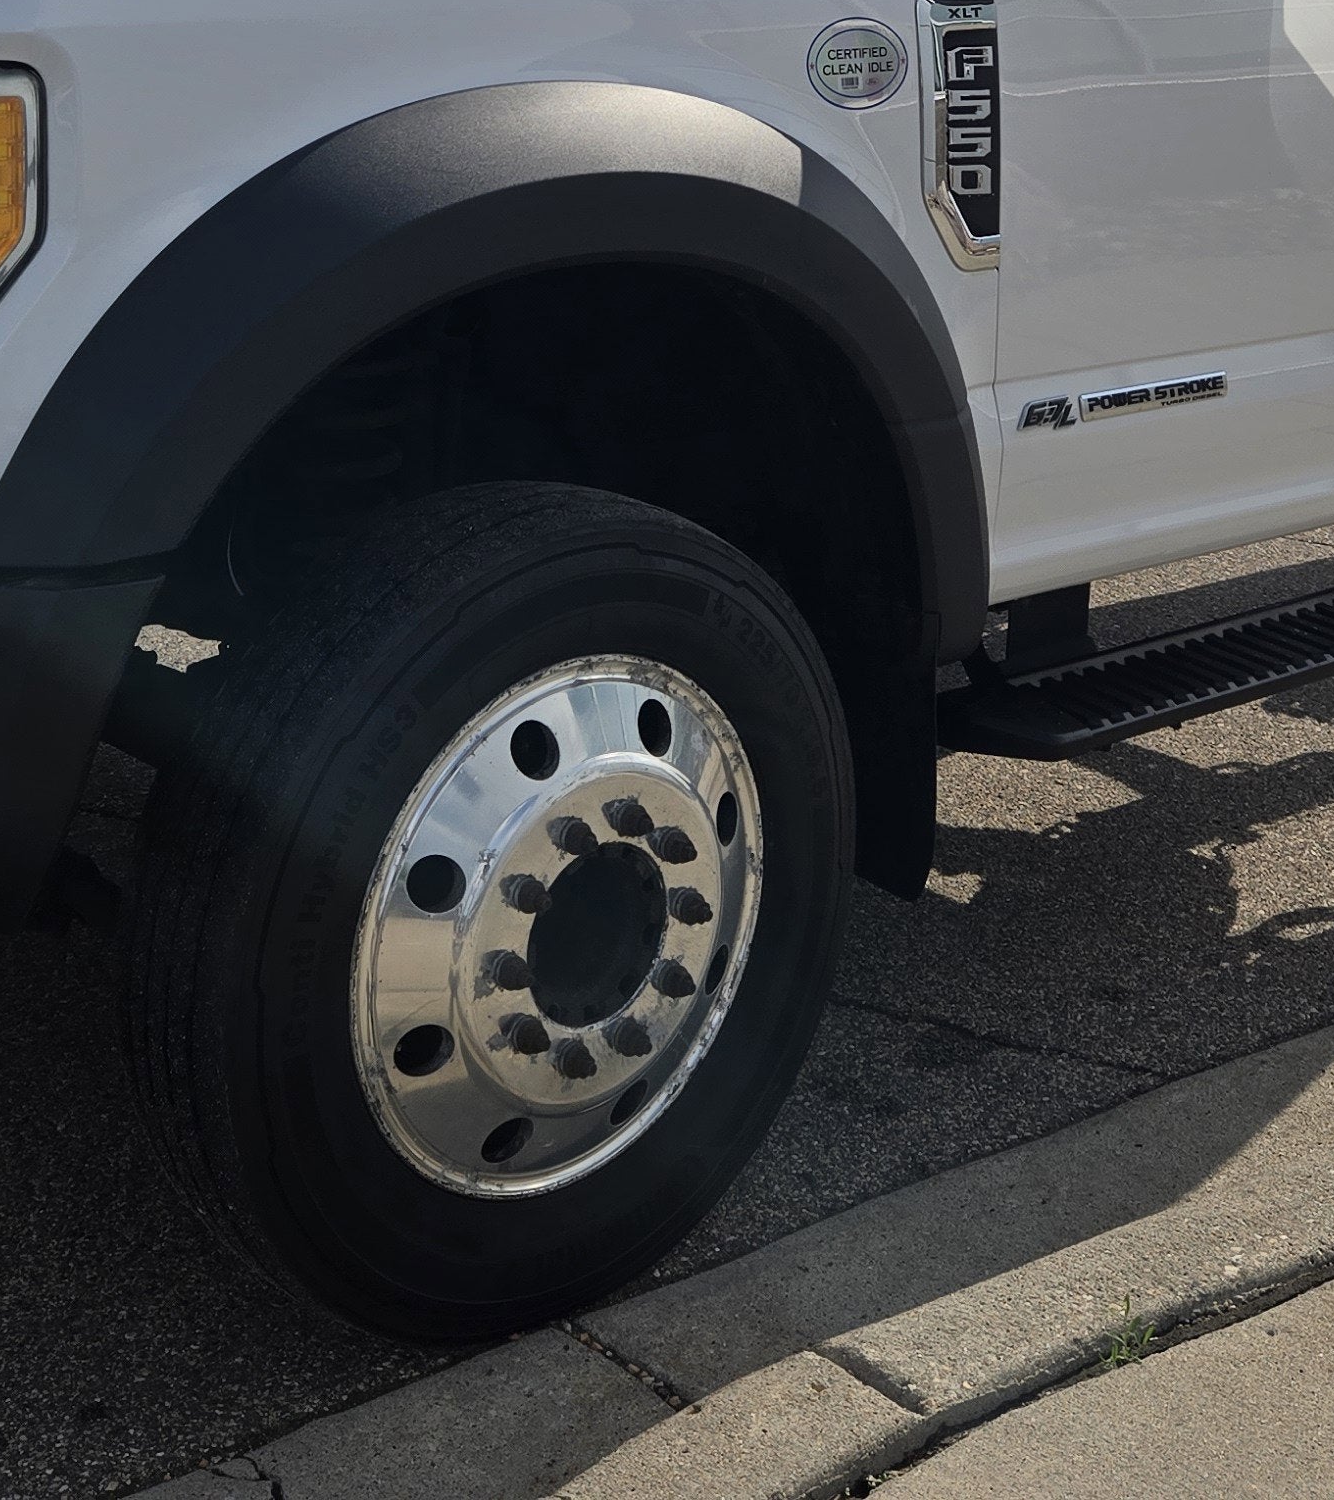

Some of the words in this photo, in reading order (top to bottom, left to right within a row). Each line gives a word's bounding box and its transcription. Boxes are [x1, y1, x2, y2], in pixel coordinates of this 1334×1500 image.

[947, 6, 983, 19] XLT
[827, 46, 888, 61] CERTIFIED
[822, 62, 863, 76] CLEAN
[868, 60, 894, 73] IDLE
[1087, 387, 1152, 413] POWER
[1154, 375, 1225, 401] STROKE
[1160, 397, 1191, 407] TURBO
[1192, 392, 1223, 401] DIESEL
